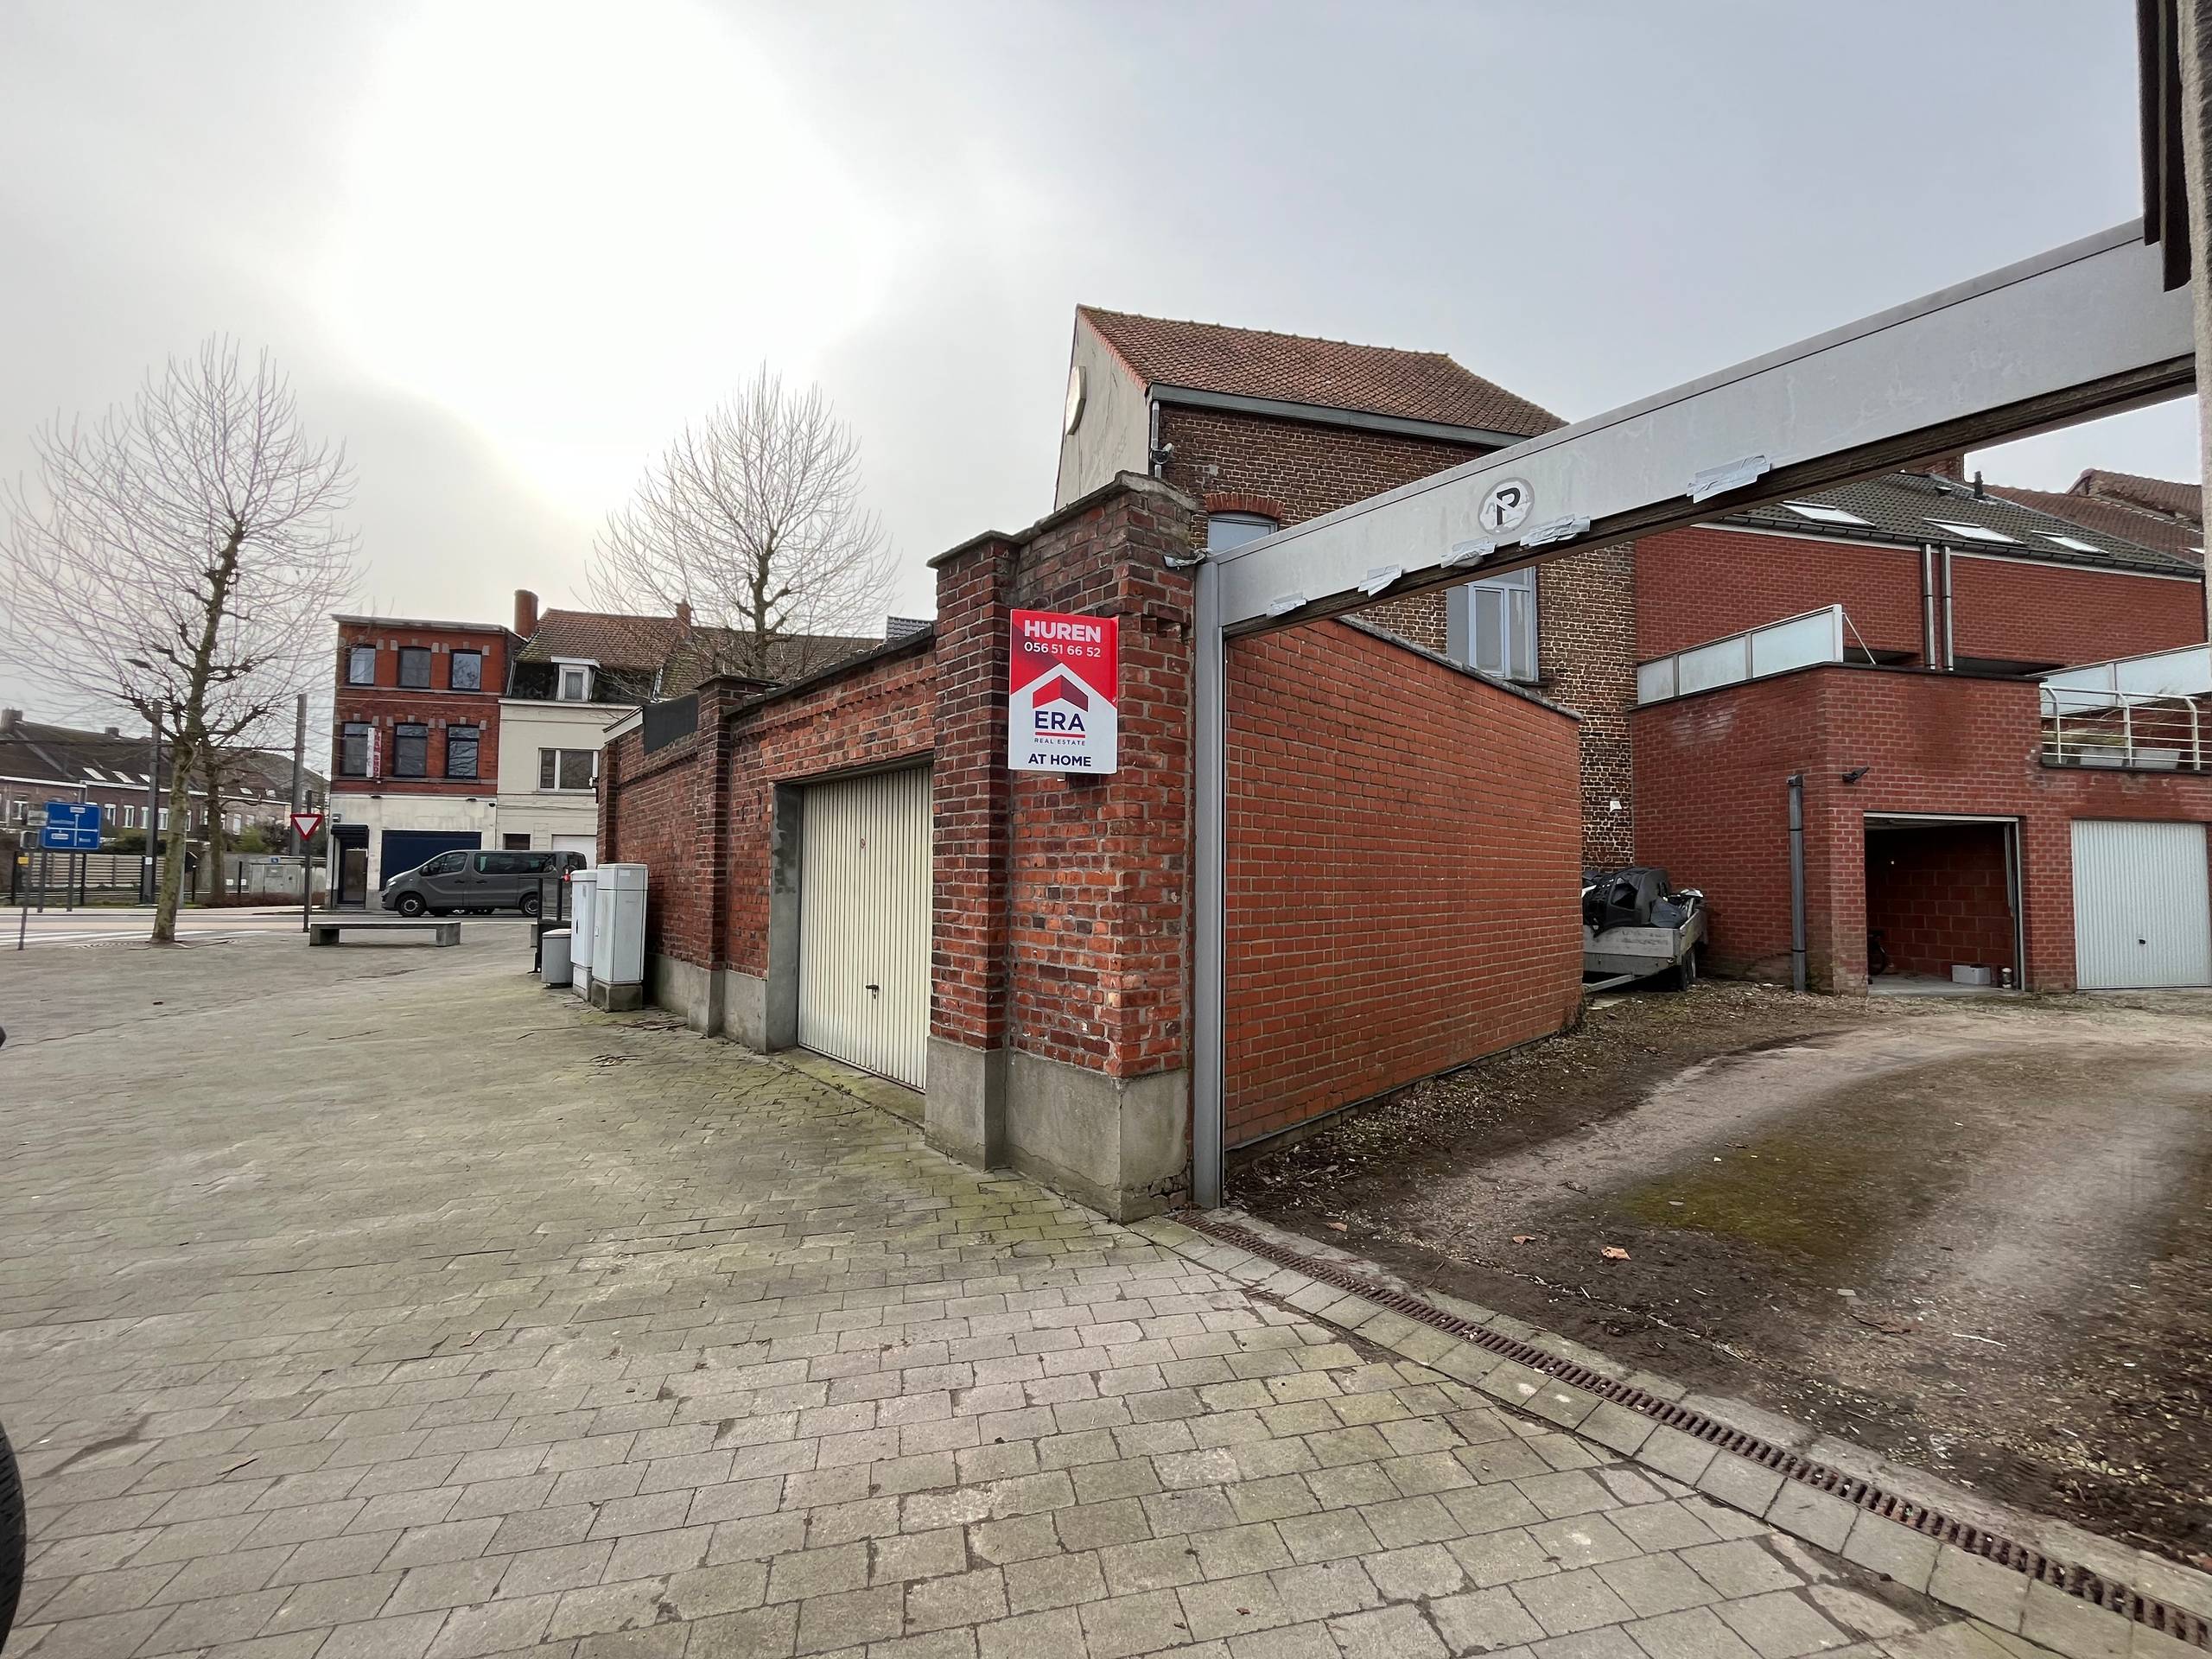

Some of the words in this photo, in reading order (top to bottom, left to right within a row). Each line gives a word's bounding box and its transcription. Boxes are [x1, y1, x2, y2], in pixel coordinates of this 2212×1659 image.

[1024, 620, 1102, 643] HUREN
[1024, 641, 1049, 653] 056
[1051, 644, 1064, 655] 51
[1066, 645, 1083, 656] 66
[1086, 646, 1101, 658] 52
[1034, 710, 1085, 732] ERA
[1028, 753, 1046, 765] AT
[1050, 754, 1091, 767] HOME
